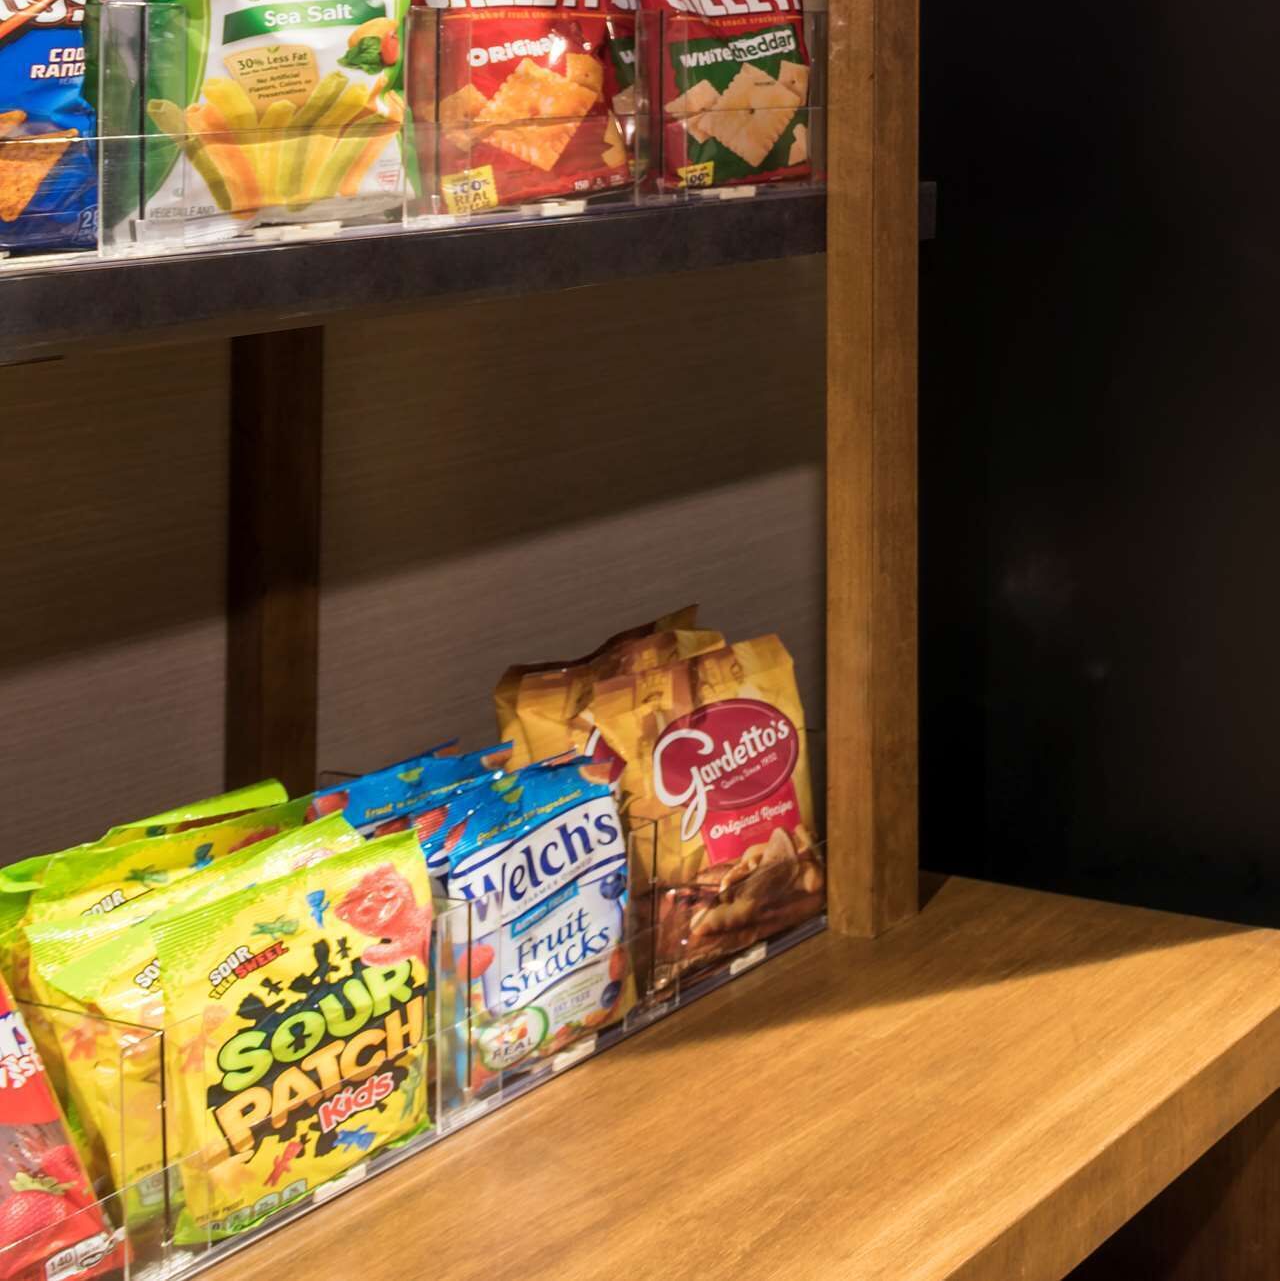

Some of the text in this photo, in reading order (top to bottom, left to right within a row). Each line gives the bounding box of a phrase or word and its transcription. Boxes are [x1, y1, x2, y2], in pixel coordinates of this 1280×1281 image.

[264, 3, 353, 27] Sea Salt
[237, 56, 265, 70] 30%
[267, 54, 290, 65] Less
[292, 52, 308, 61] Fat
[653, 719, 790, 842] Gardetto's
[709, 799, 794, 839] Original Recipe
[459, 813, 620, 923] Welch's
[208, 945, 255, 987] SOUR
[499, 926, 611, 1008] Snacks
[517, 906, 592, 972] Fruit
[218, 958, 414, 1093] SOUR
[214, 996, 425, 1152] PATCH
[318, 1070, 395, 1134] Kids
